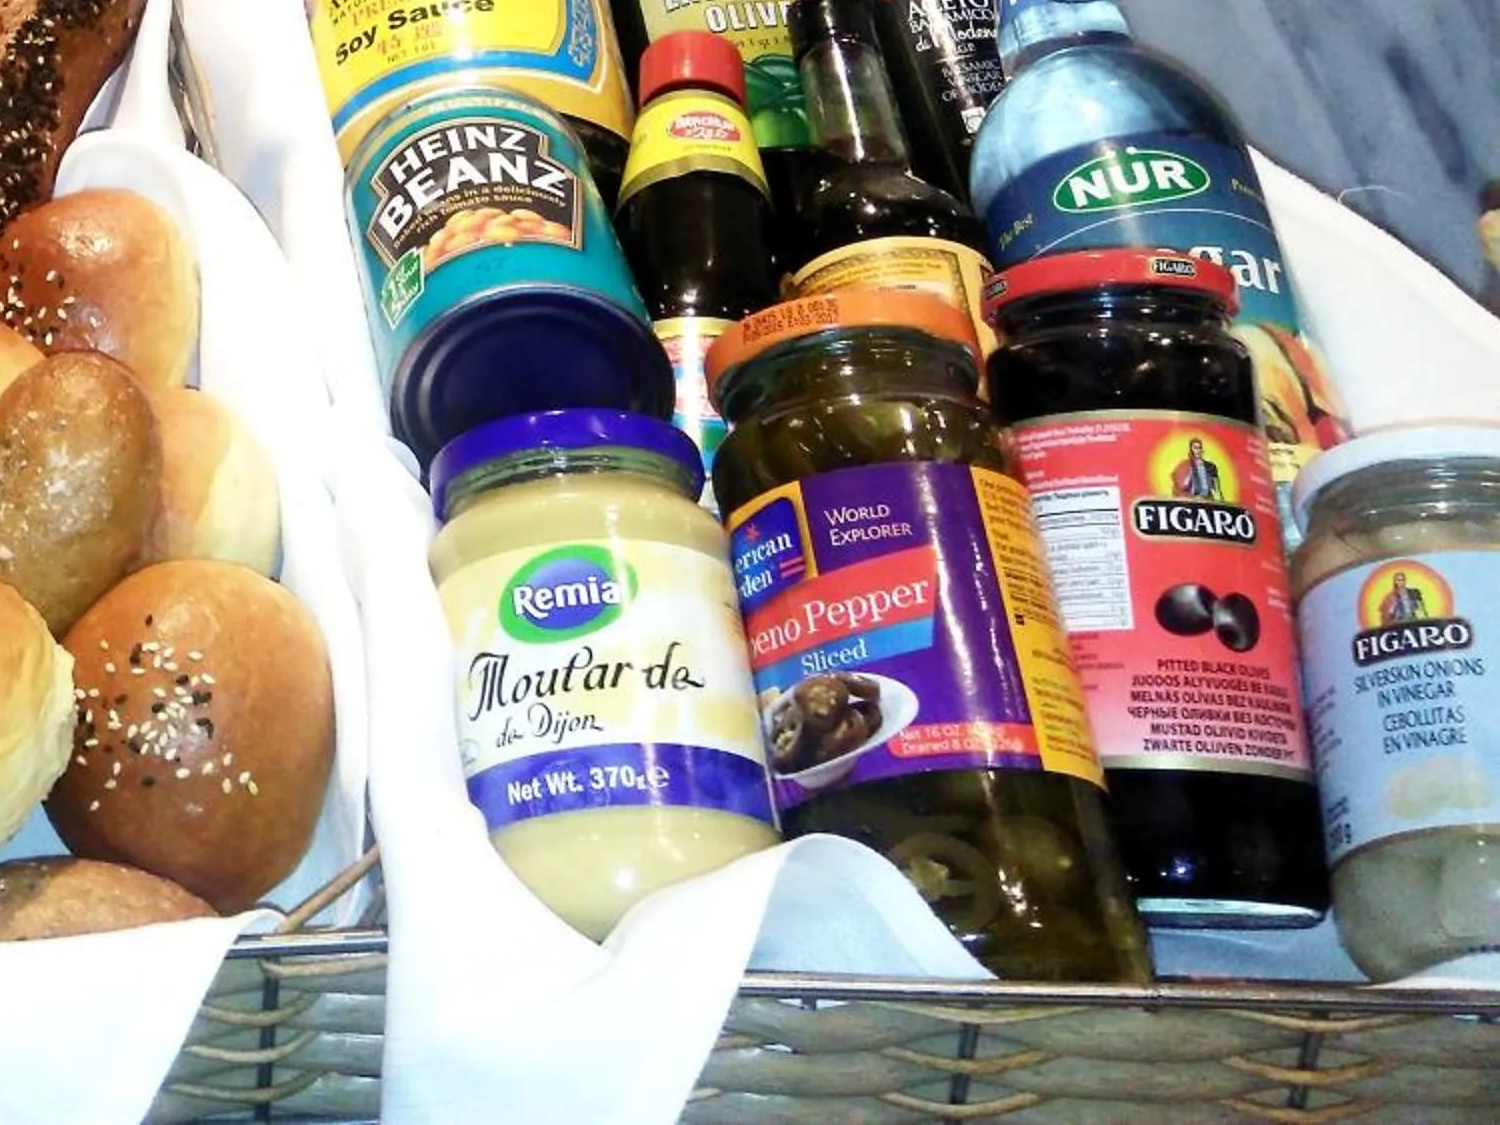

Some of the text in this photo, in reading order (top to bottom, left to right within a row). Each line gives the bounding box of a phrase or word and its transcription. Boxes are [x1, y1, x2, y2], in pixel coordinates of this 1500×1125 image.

[335, 25, 378, 67] Soy
[388, 124, 528, 185] HEINZ
[377, 151, 572, 241] BEANZ
[822, 502, 892, 527] WORLD
[1137, 505, 1255, 539] FIGARO
[828, 521, 914, 547] EXPLORER
[511, 575, 622, 619] Remia
[802, 577, 930, 635] Pepper
[800, 638, 869, 676] Sliced
[1355, 623, 1470, 660] FIGARO
[1156, 658, 1200, 674] PITTED
[1201, 660, 1237, 677] BLACK
[1422, 657, 1486, 678] ONIONS
[1377, 680, 1456, 708] IN VINEGAR
[527, 701, 605, 745] Dijon
[1382, 727, 1468, 755] EN VINAGRE
[507, 778, 542, 806] Net
[546, 771, 584, 795] Wt.
